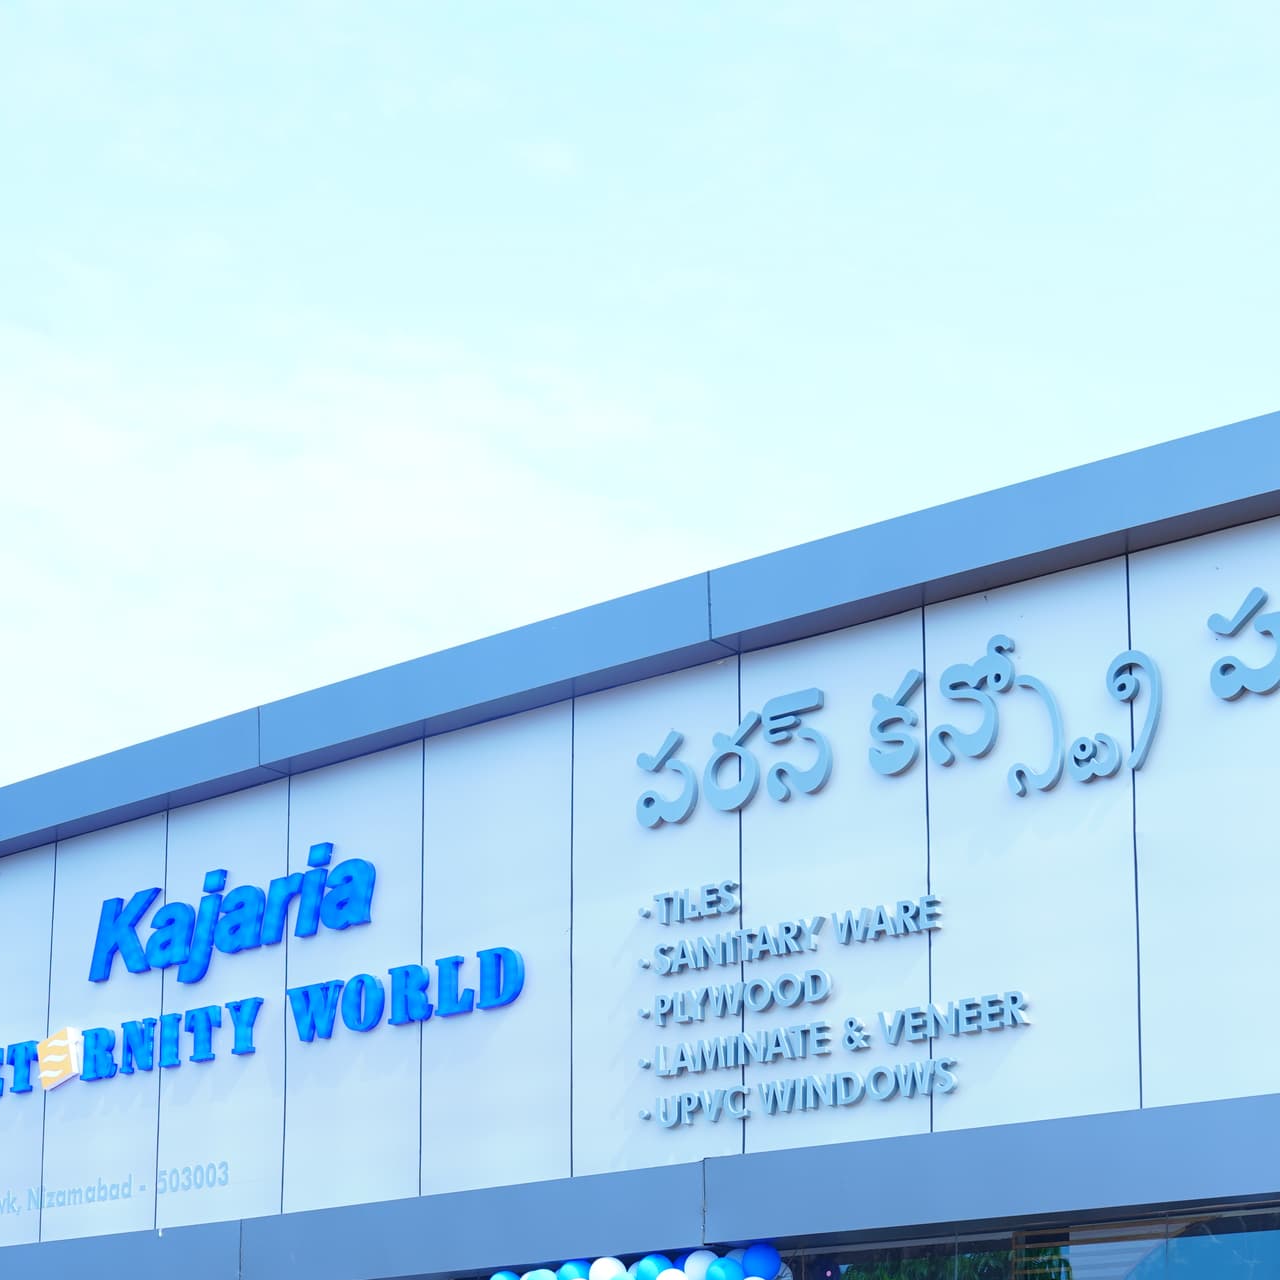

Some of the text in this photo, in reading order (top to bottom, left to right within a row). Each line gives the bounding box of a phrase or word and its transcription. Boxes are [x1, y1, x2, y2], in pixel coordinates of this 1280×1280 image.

[635, 687, 833, 829] పరస్
[87, 841, 377, 985] Kajaria
[653, 879, 740, 926] TILES
[653, 894, 944, 976] SANITARY WARE
[286, 946, 526, 1043] WORLD
[654, 968, 834, 1027] PLYWOOD
[654, 990, 1033, 1078] LAMINATE & VENEER
[654, 1056, 960, 1130] UPVC WINDOWS
[27, 1173, 133, 1211] Nizamabad
[157, 1161, 230, 1195] 503003
